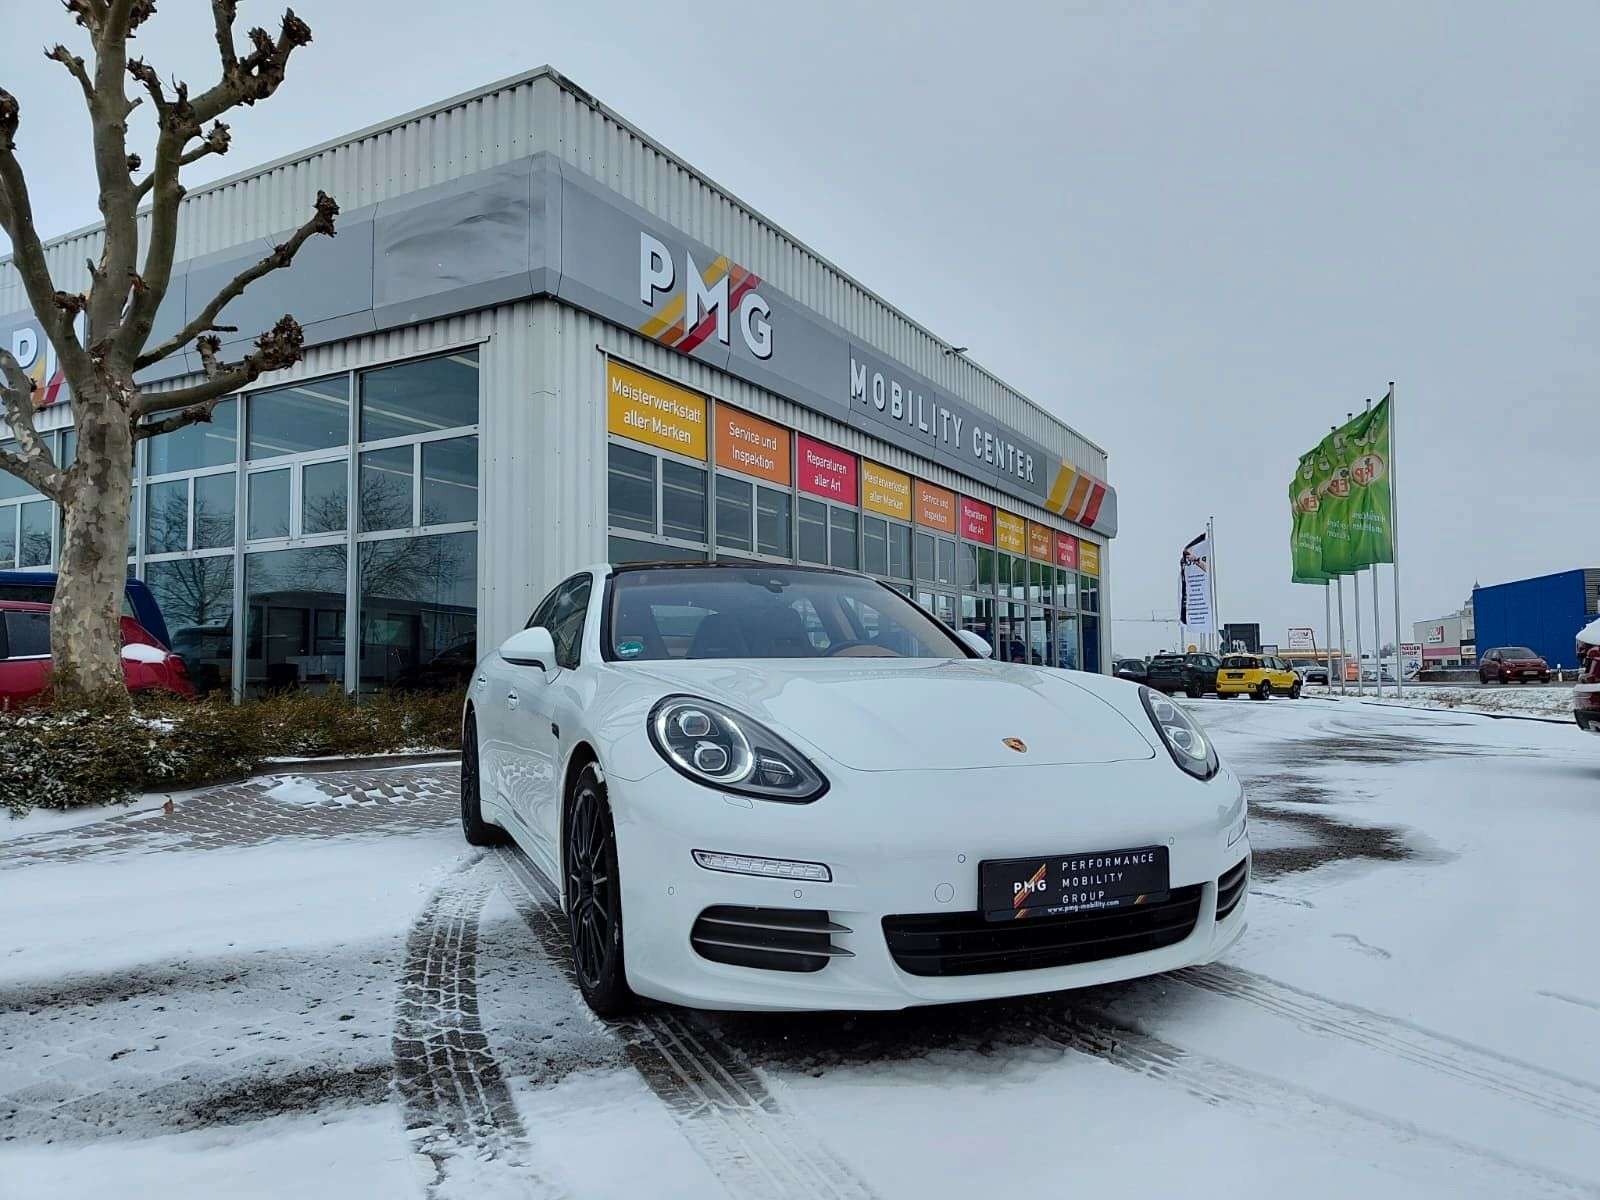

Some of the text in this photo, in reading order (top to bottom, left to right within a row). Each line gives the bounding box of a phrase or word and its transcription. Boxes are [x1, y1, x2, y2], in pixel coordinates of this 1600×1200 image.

[640, 231, 774, 360] PMG
[612, 377, 702, 423] Meisterwerkstatt
[624, 409, 691, 444] aller Marken
[850, 358, 1035, 484] MOBILITY CENTER
[729, 422, 777, 451] Service und
[732, 445, 774, 470] Inspektion
[807, 450, 847, 474] Reparaturen
[814, 474, 841, 492] aller Art
[1062, 853, 1154, 871] PERFORMANCE
[1014, 880, 1047, 894] PMG
[1062, 872, 1123, 888] MOBILITY
[1047, 899, 1120, 914] www.pmg-mobility.com
[1062, 890, 1105, 904] GROUP
